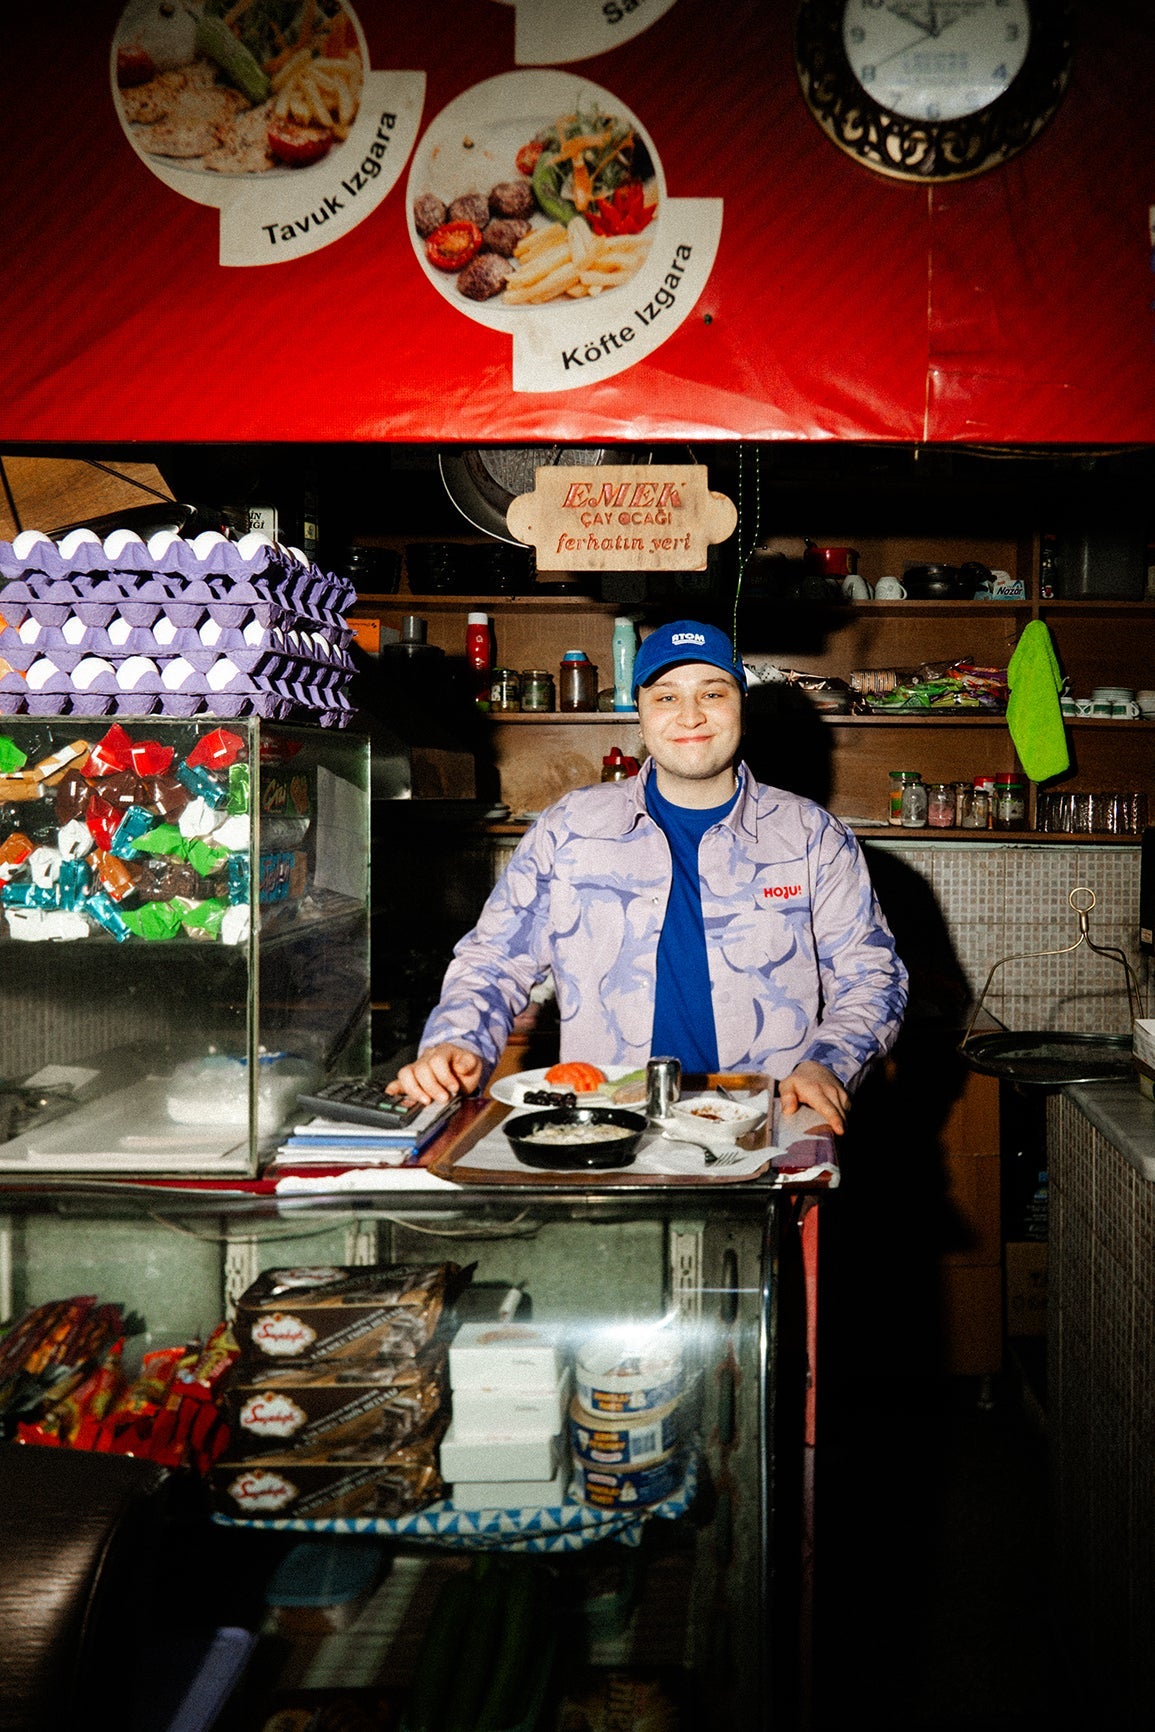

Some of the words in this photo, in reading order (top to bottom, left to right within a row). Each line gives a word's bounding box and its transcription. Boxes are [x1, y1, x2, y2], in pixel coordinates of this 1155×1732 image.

[262, 196, 345, 245] Tavuk
[341, 112, 398, 197] Izgara
[561, 326, 636, 370] Köfte
[634, 244, 693, 326] Izgara
[562, 482, 685, 509] EMEK
[580, 512, 612, 528] ÇAY
[618, 509, 672, 526] OCAĞI
[649, 532, 691, 553] yeri
[671, 632, 706, 644] ATOM
[763, 885, 802, 900] HOJU!
